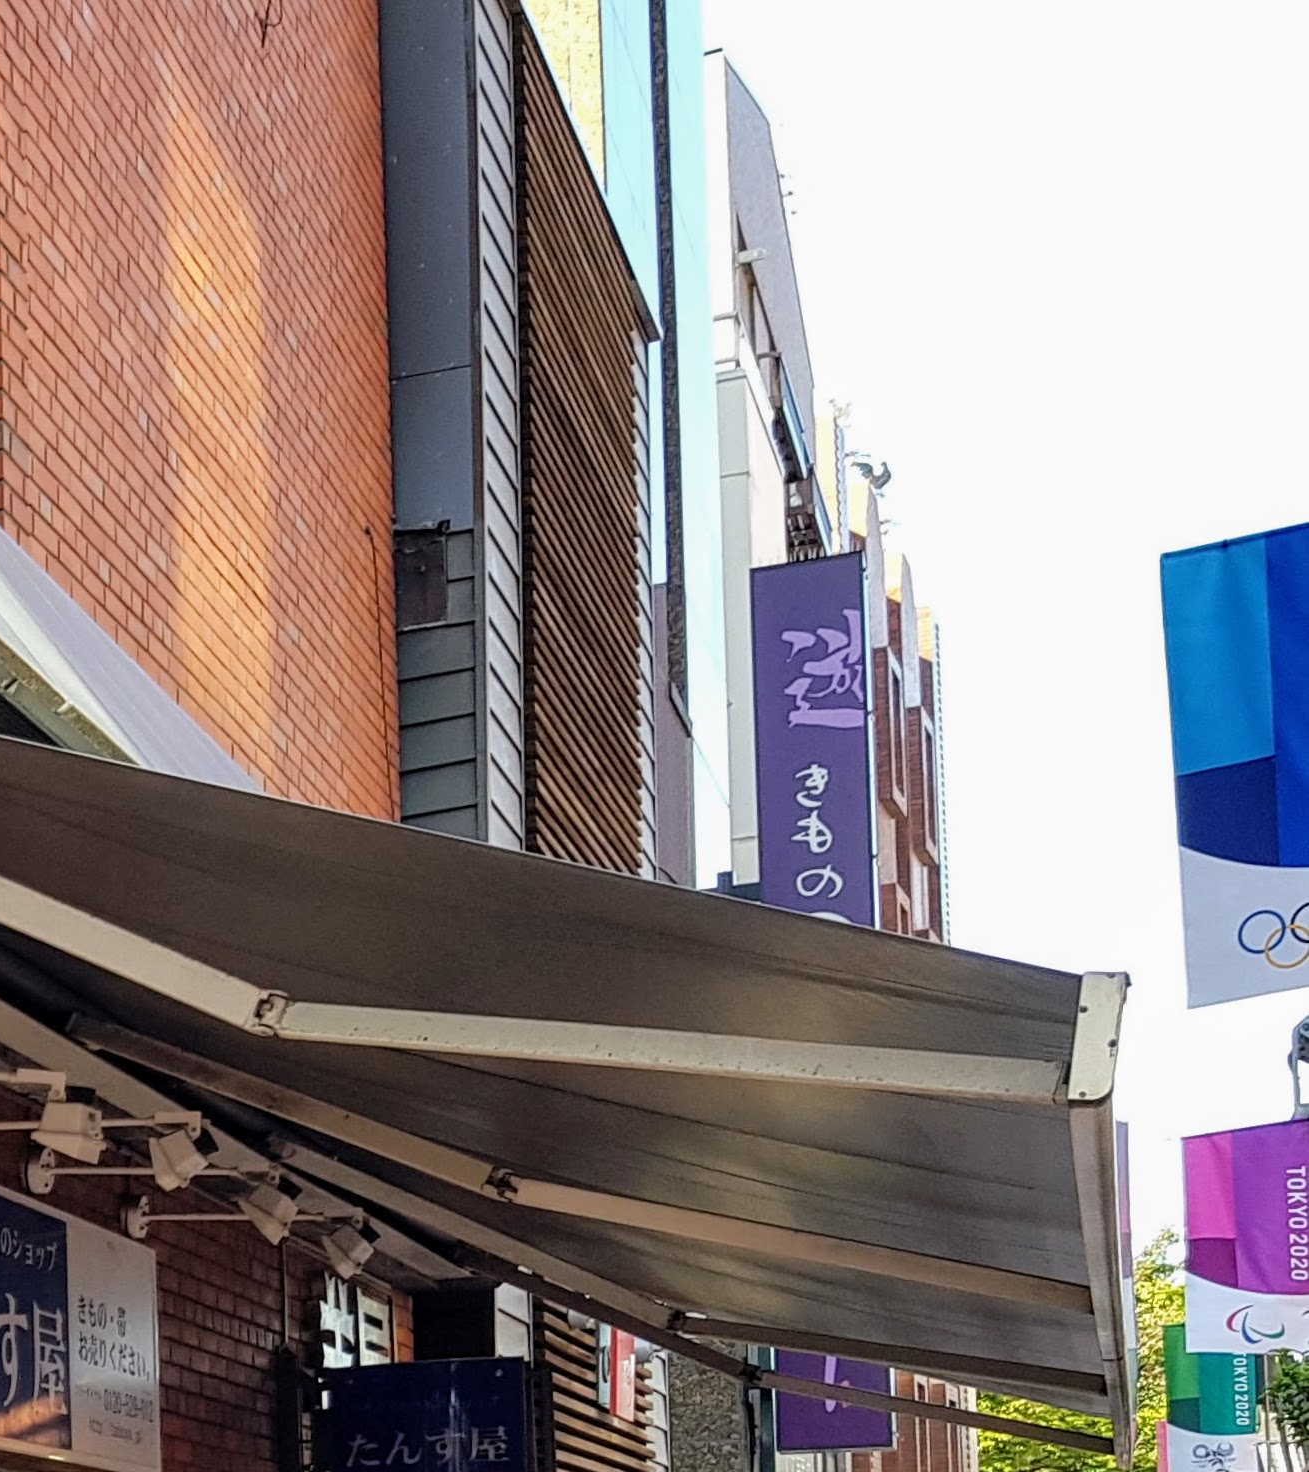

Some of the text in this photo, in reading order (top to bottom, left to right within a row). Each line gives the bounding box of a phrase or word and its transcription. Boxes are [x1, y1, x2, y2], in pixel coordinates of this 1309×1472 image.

[790, 762, 854, 924] きもの
[1285, 1165, 1309, 1281] TOKYO 2020
[346, 1425, 510, 1468] たんす屋
[1235, 1394, 1251, 1427] 2020
